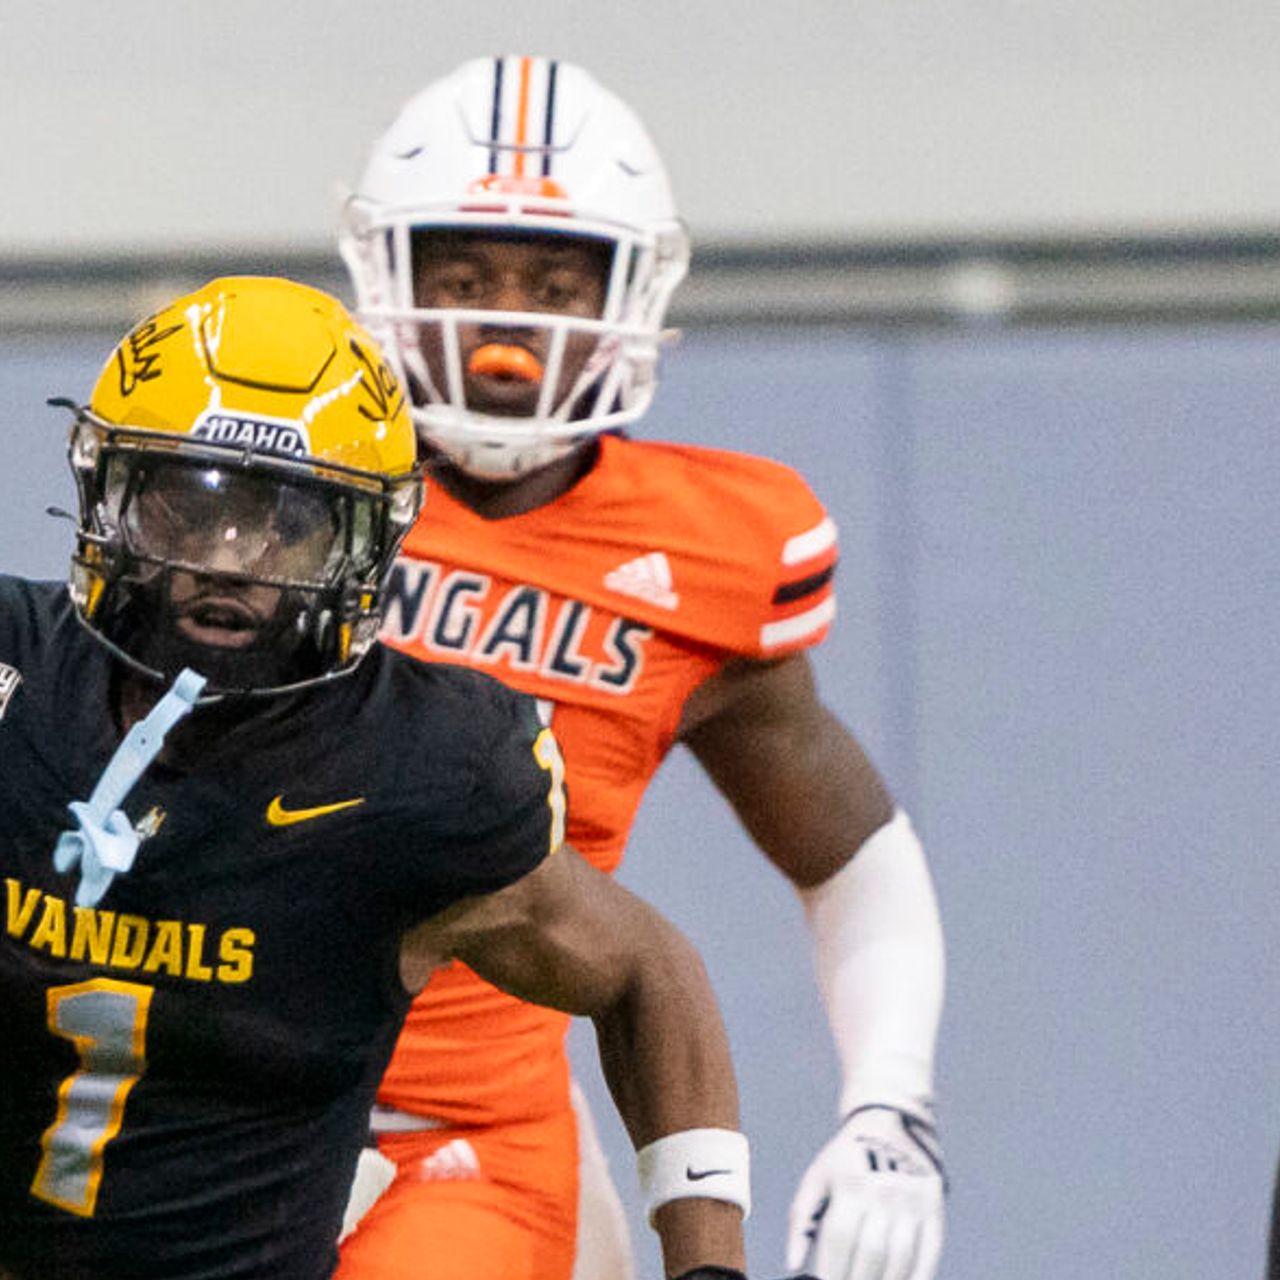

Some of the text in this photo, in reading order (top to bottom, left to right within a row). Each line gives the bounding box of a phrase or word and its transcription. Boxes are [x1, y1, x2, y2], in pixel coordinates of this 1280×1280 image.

[204, 415, 298, 453] IDAHO
[377, 555, 653, 696] NGALS
[4, 878, 255, 983] VANDALS
[30, 977, 154, 1218] 1
